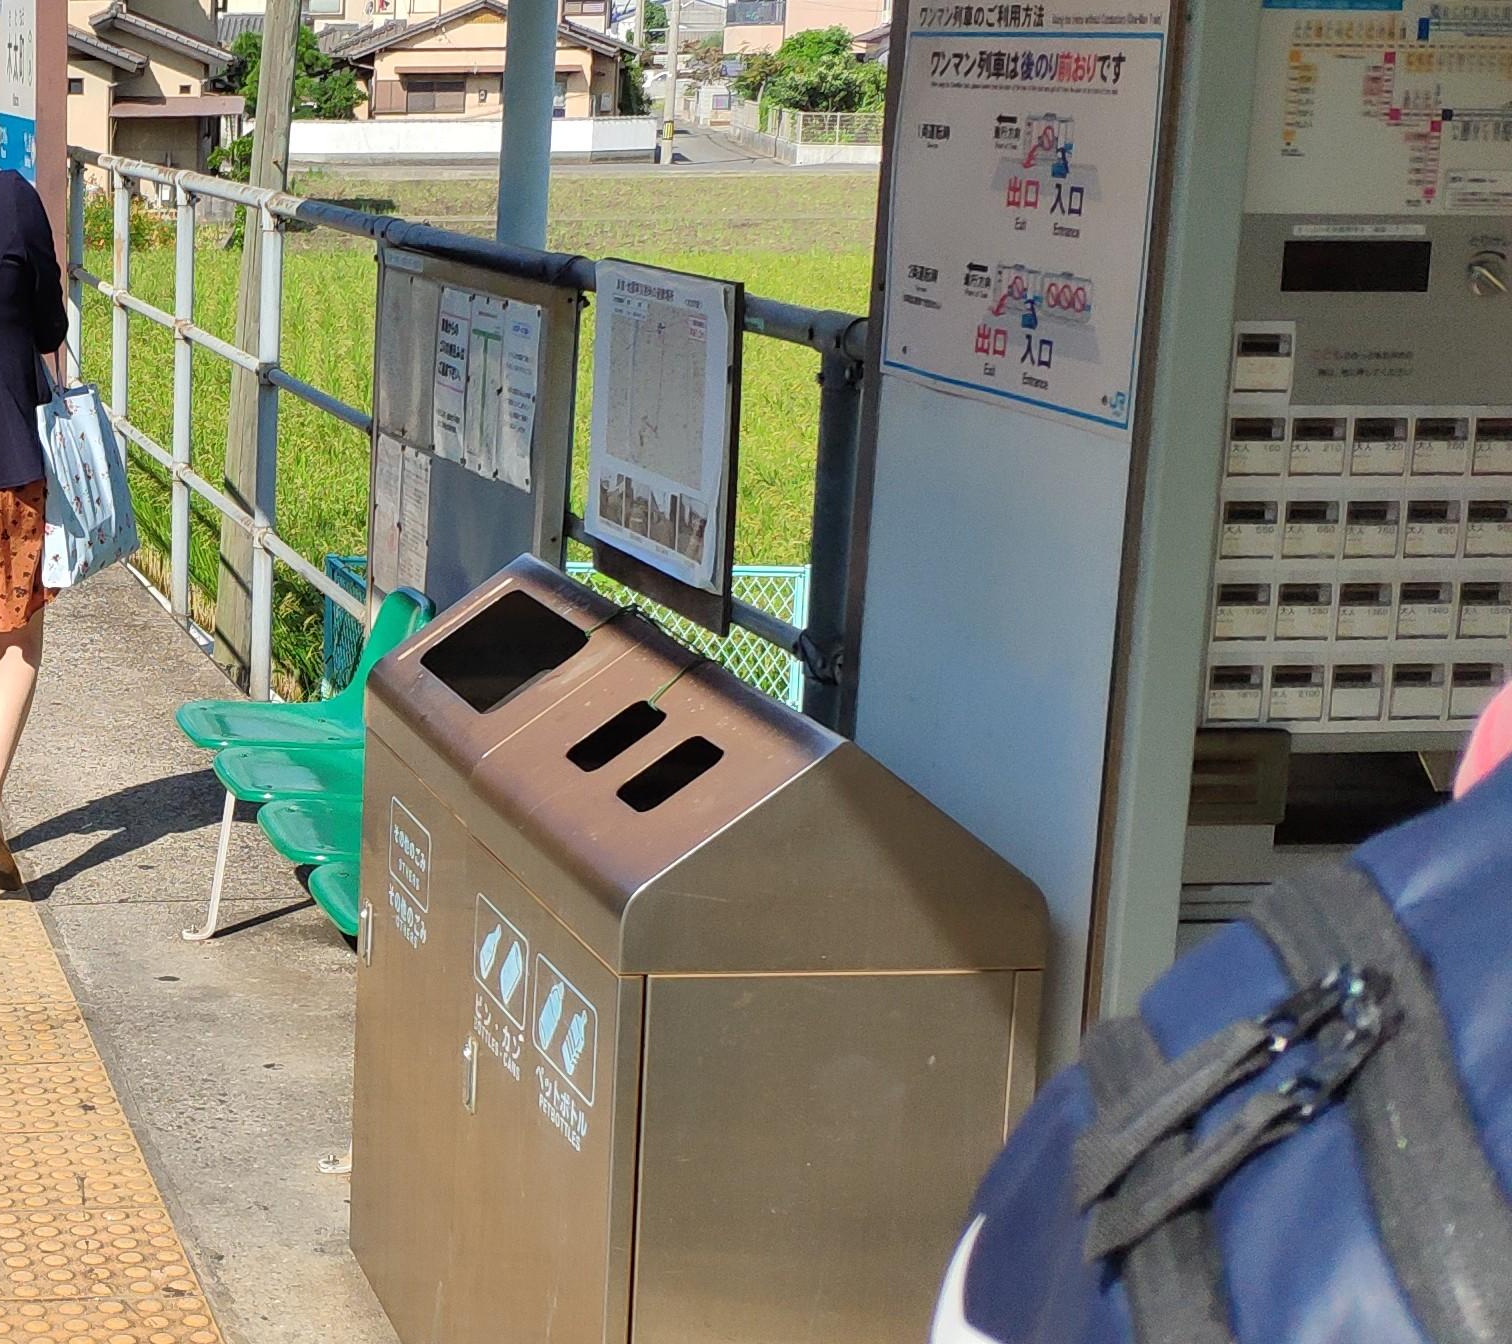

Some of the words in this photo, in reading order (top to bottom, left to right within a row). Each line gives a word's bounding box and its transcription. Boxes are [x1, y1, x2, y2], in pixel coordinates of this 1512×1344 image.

[919, 4, 1045, 28] ワンマン列車のご利用方法
[929, 50, 1126, 84] ワンマン列車は後のり前おりです
[1006, 176, 1040, 208] 出口
[1049, 183, 1085, 216] 入口
[1013, 217, 1027, 231] Exit
[1052, 223, 1081, 238] Entrance
[974, 323, 1008, 357] 出口
[1020, 334, 1054, 369] 入口
[1022, 372, 1049, 391] Entrance
[388, 882, 427, 945] その他のごみ
[535, 1065, 588, 1137] ペットボトル
